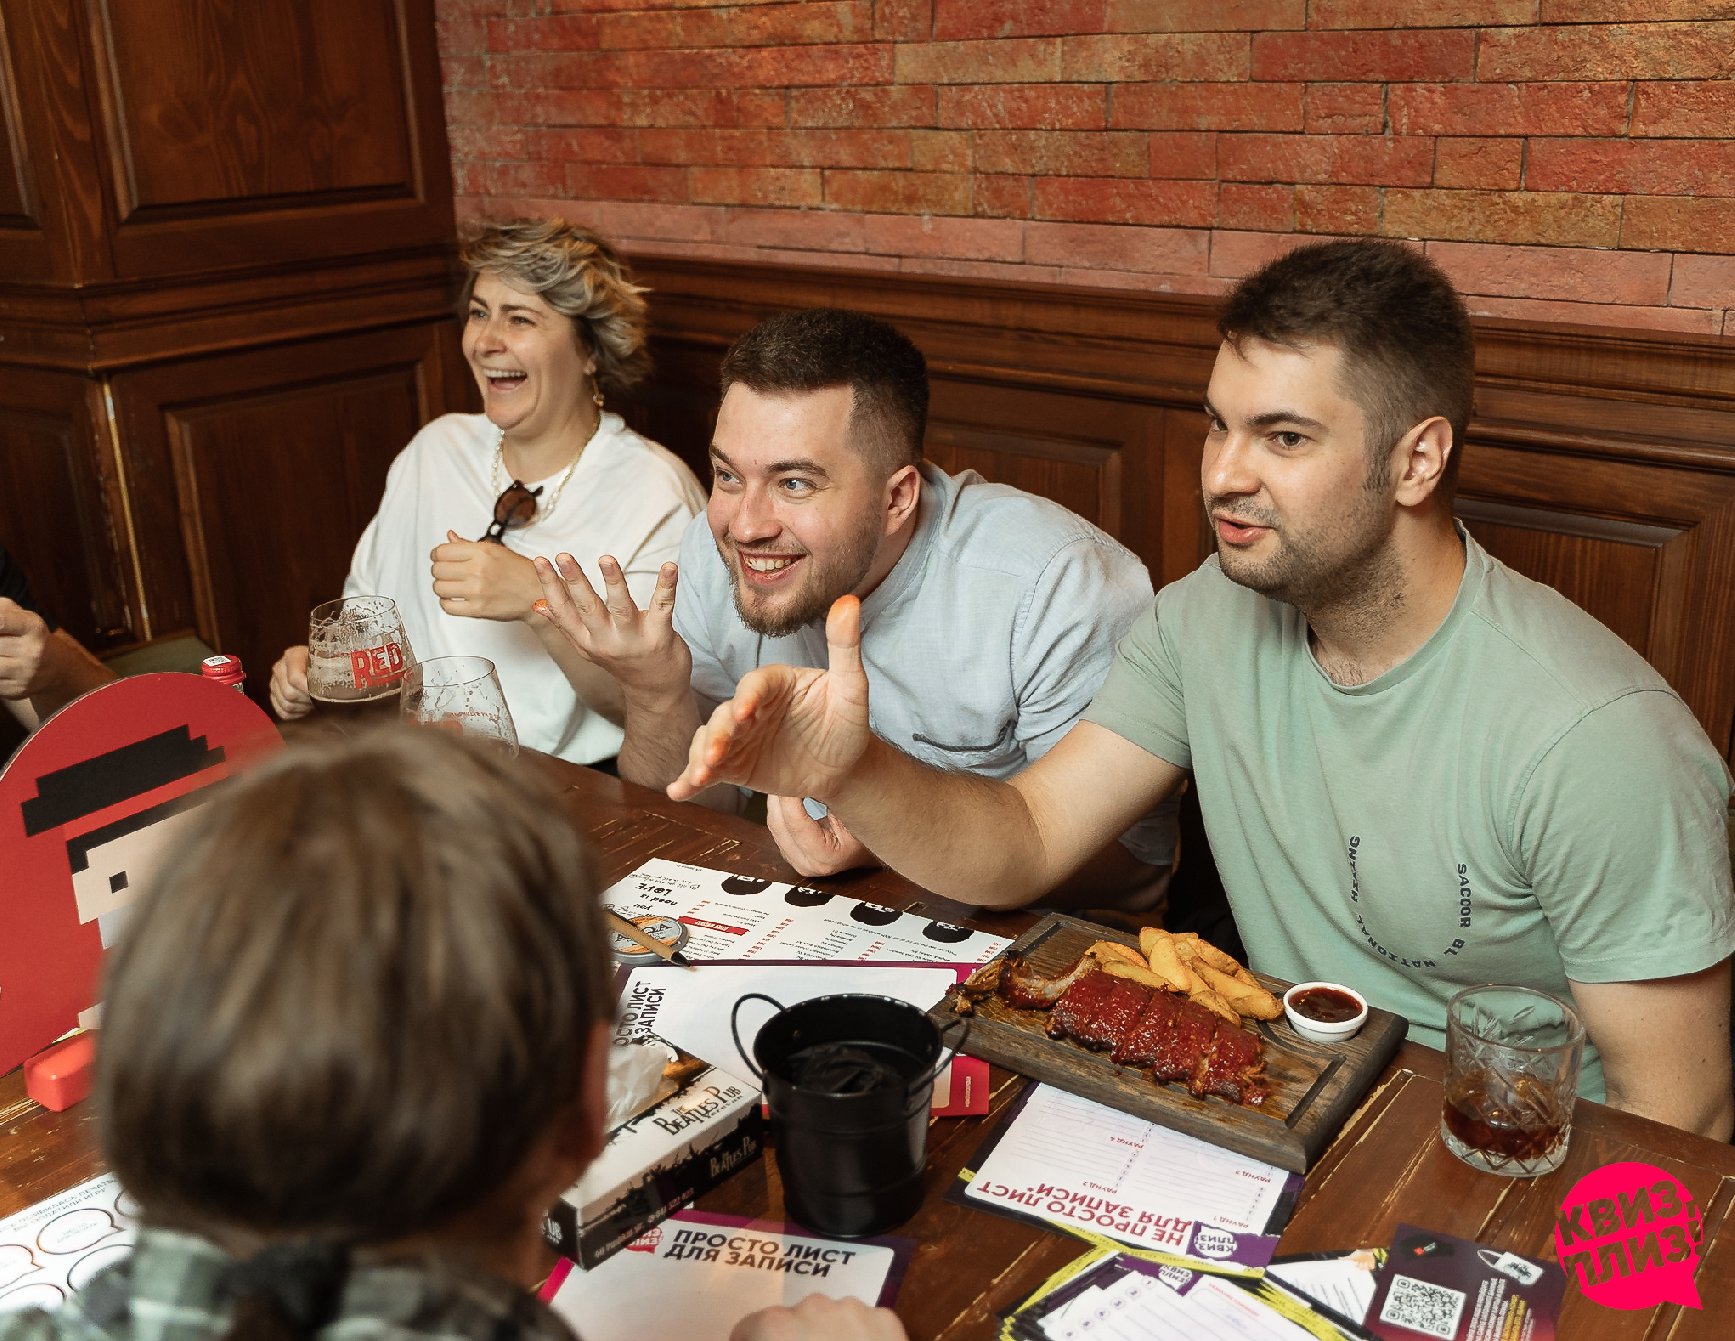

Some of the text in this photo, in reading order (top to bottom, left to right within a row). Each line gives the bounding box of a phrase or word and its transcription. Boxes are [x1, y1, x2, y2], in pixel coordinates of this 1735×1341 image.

[351, 642, 403, 689] RED
[1457, 863, 1472, 928] SACOOR
[611, 981, 651, 1046] ОСТО ЛИСТ
[977, 1180, 1185, 1247] НЕ ПРОСТО ЛИСТ
[1138, 1210, 1193, 1234] ДЛЯ
[662, 1243, 831, 1279] ДЛЯ ЗАПИСИ
[672, 1229, 857, 1265] ПРОСТО ЛИСТ
